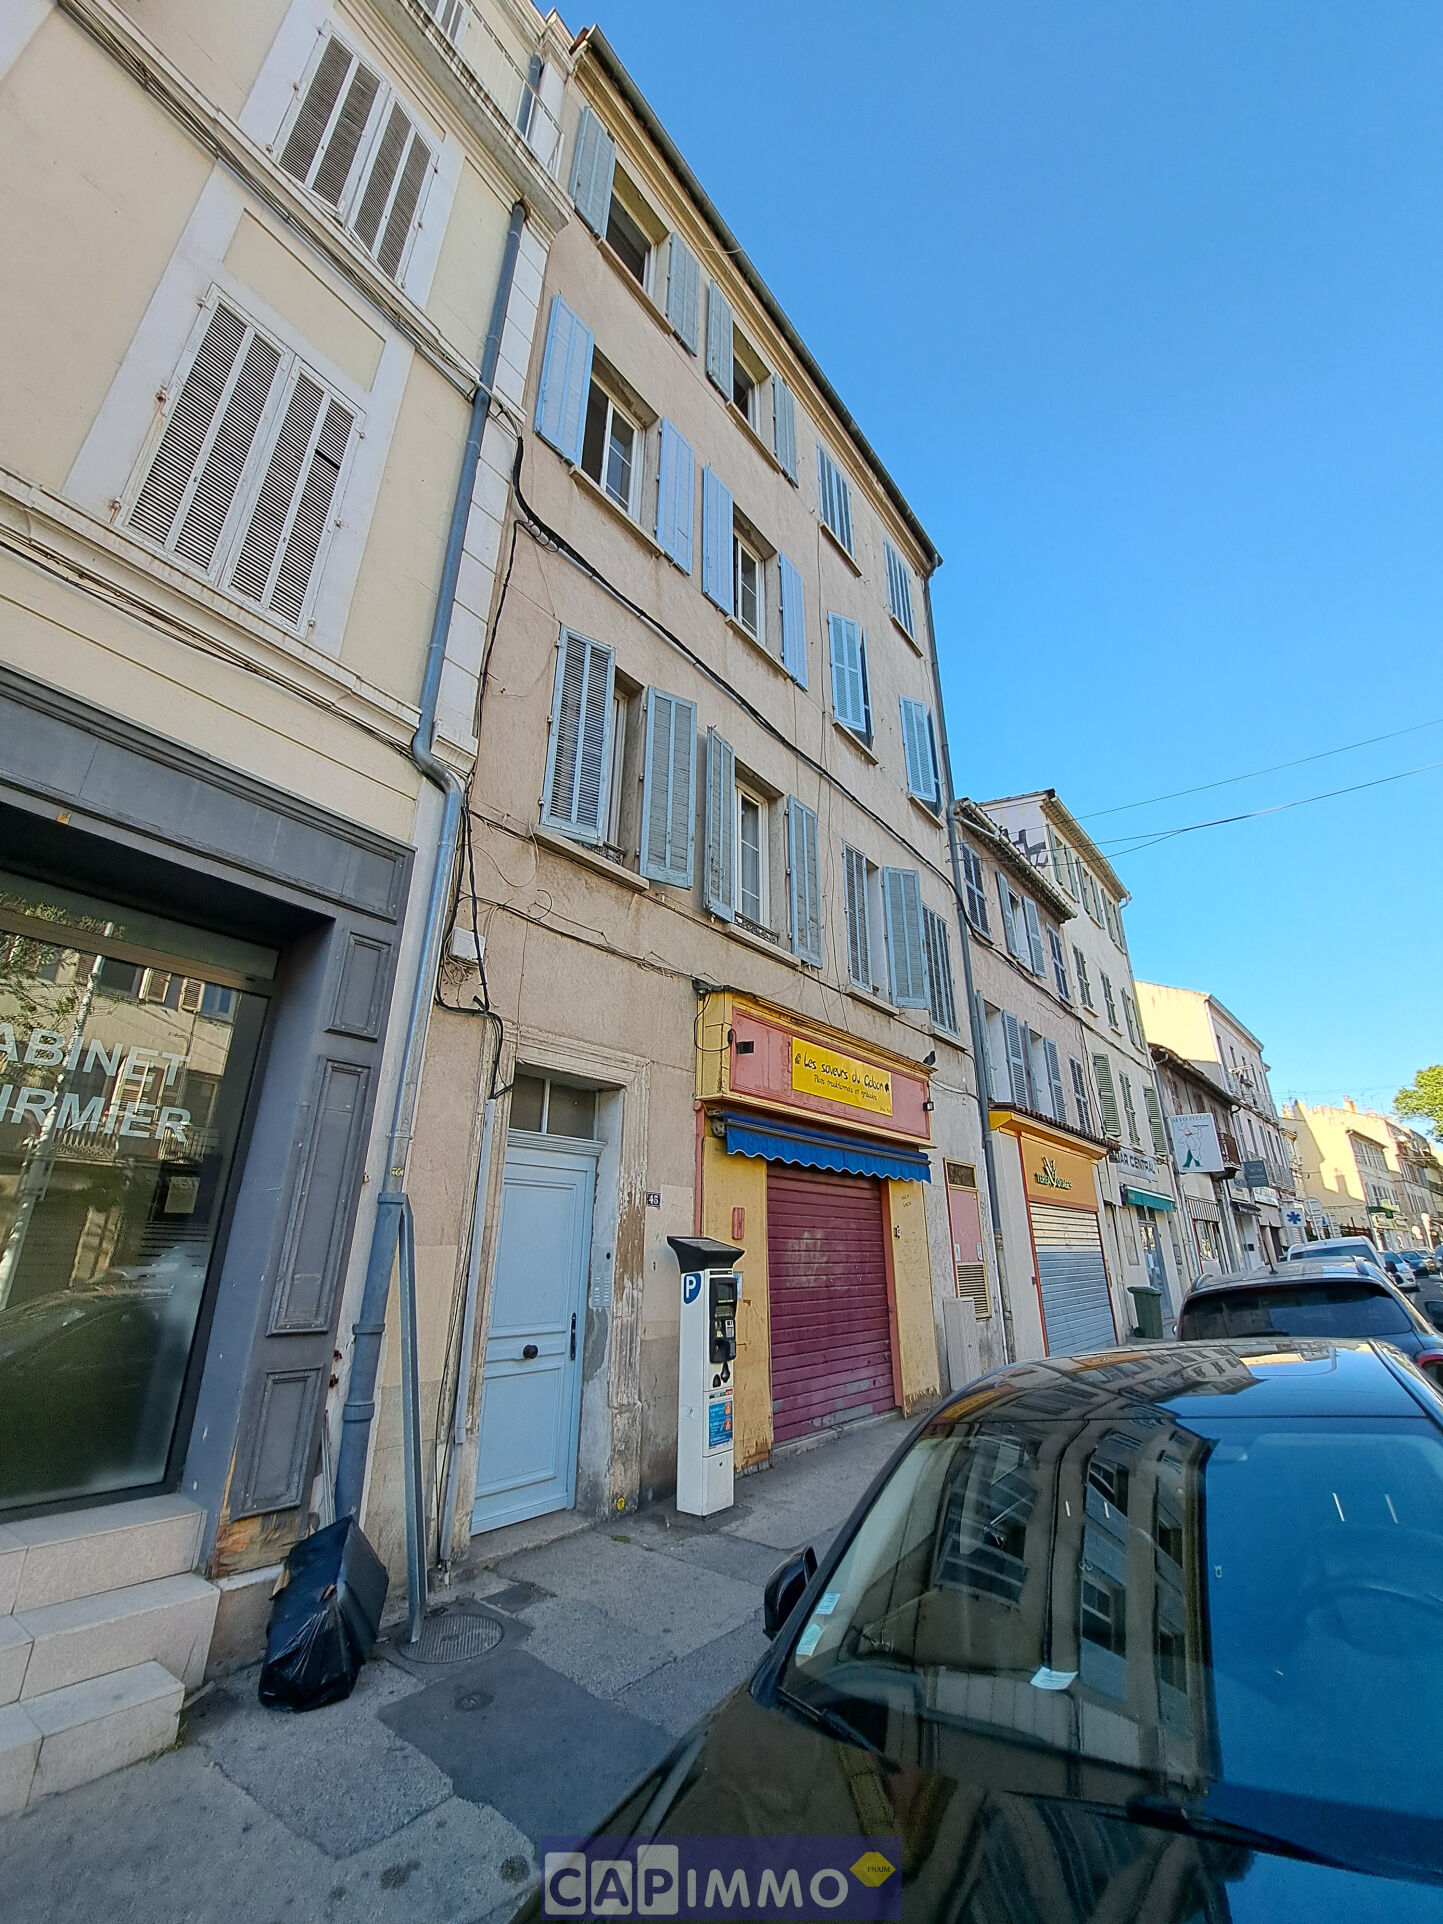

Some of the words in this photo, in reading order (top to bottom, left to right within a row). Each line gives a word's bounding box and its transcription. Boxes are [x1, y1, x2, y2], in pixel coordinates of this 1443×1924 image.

[803, 1051, 817, 1070] Les
[821, 1063, 848, 1081] saveurs
[851, 1069, 861, 1085] du
[864, 1074, 884, 1091] Gabon
[648, 1194, 659, 1205] 45
[686, 1276, 696, 1298] P
